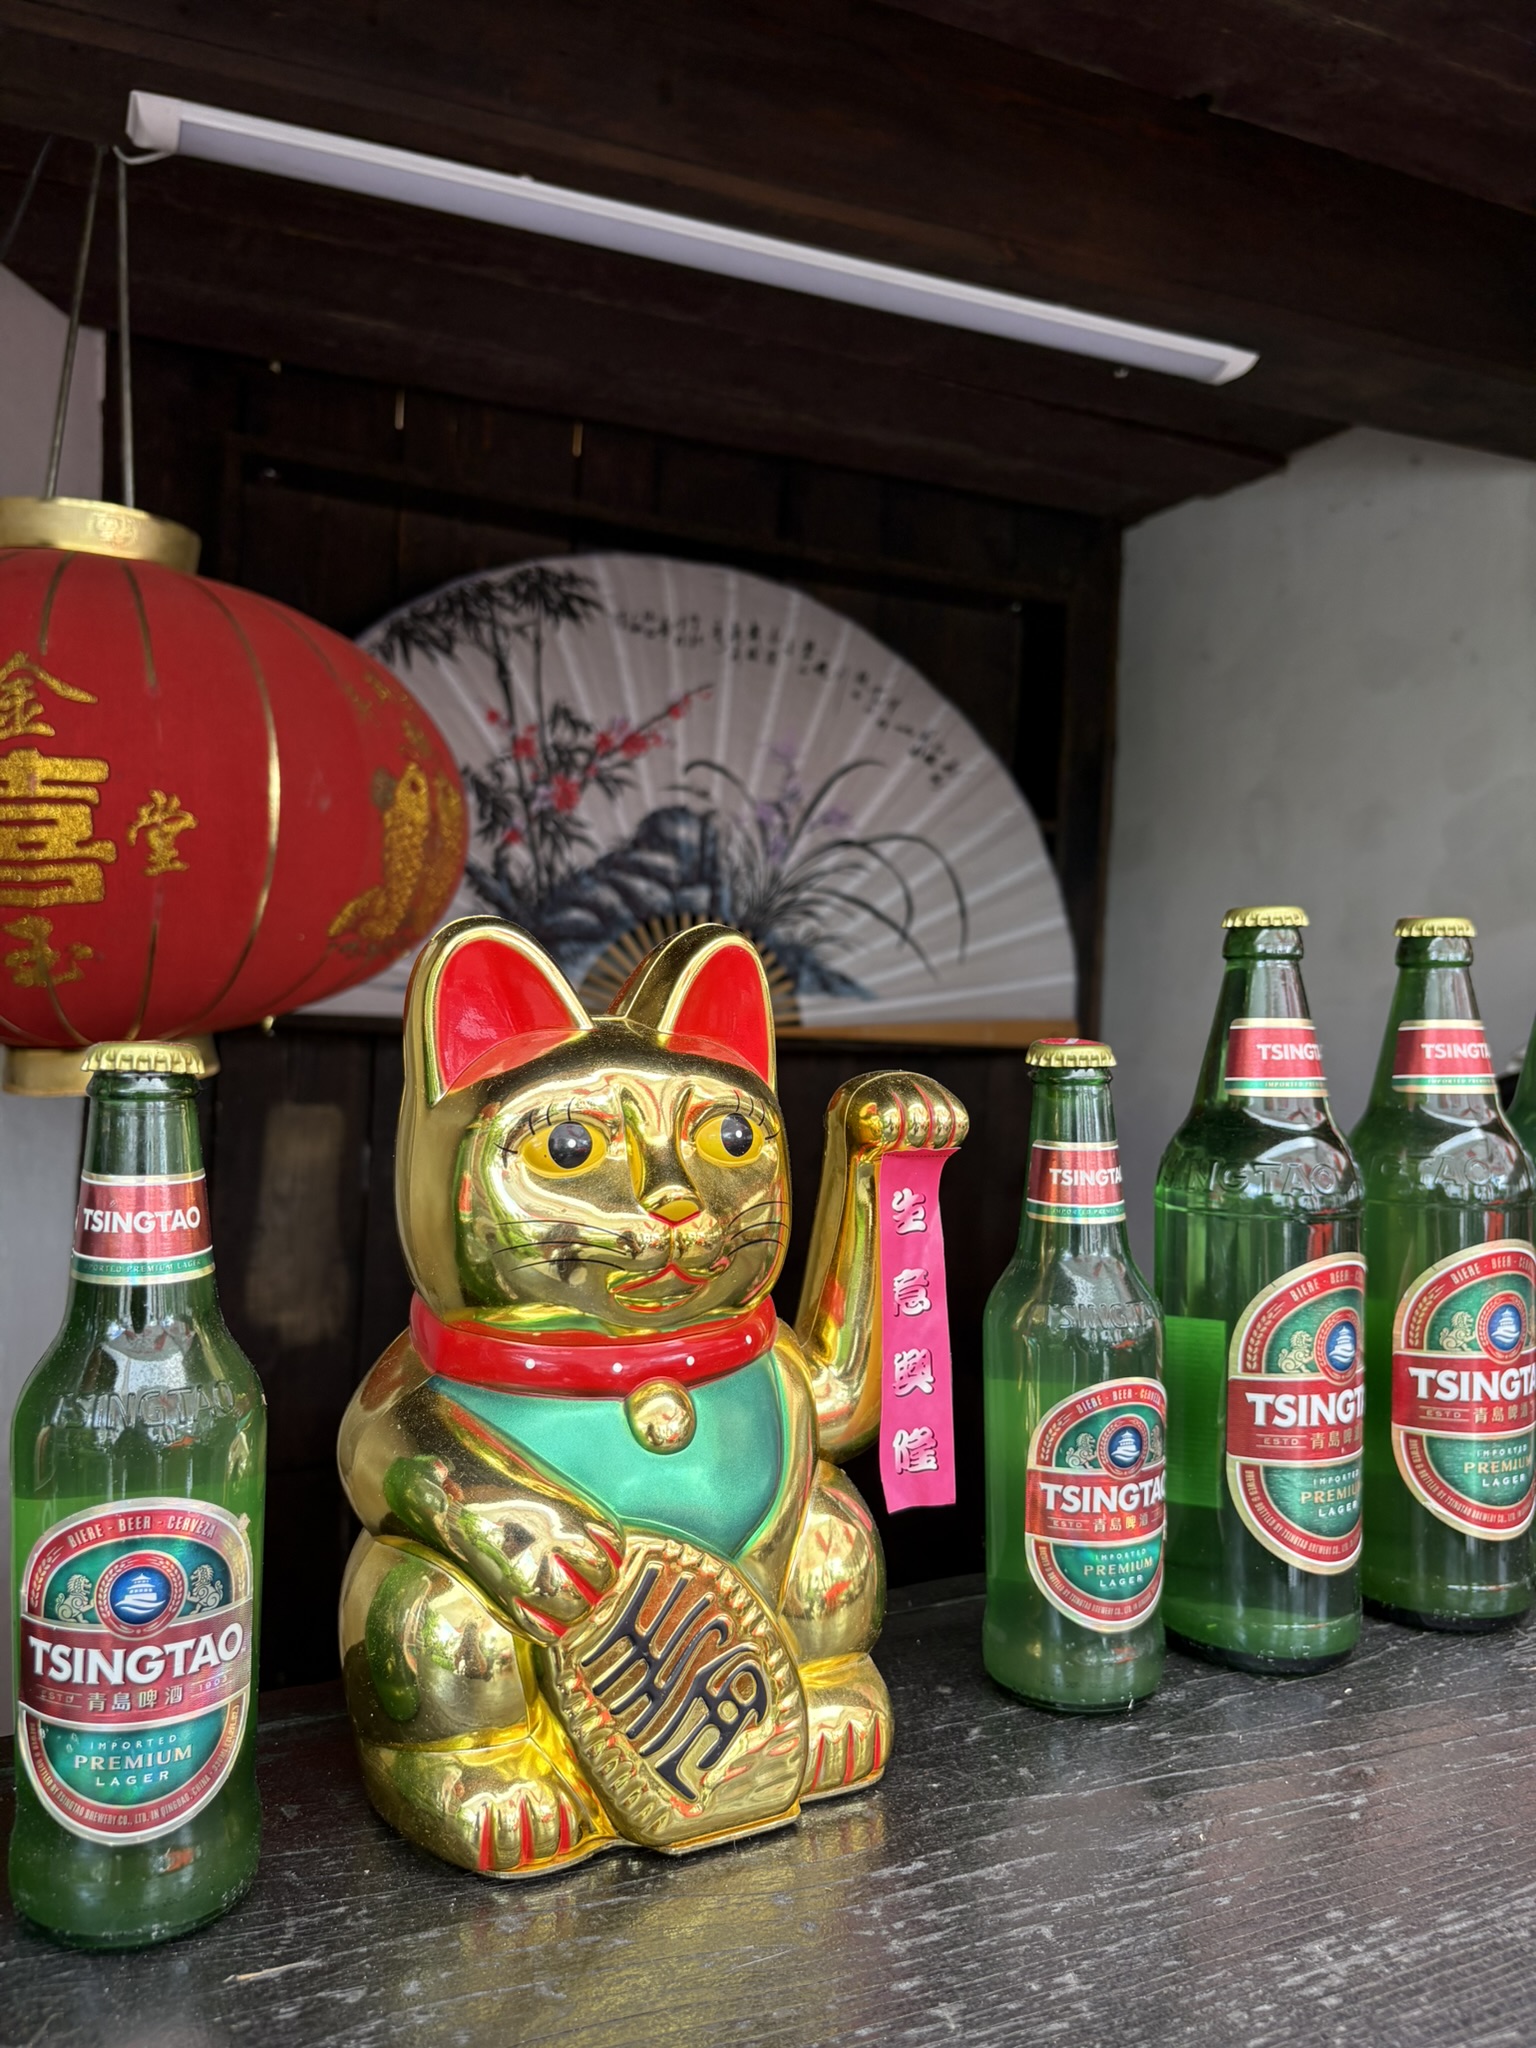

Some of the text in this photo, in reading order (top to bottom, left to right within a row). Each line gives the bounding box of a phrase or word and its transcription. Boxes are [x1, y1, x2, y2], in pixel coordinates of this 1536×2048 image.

[83, 1205, 201, 1234] TSINGTAO
[1450, 1262, 1481, 1285] BIERE
[1491, 1255, 1511, 1270] BEER
[1289, 1278, 1320, 1302] BIERE
[1329, 1269, 1349, 1284] BEER
[1075, 1395, 1103, 1414] BIERE
[1112, 1388, 1132, 1401] BEER
[1482, 1473, 1525, 1487] LAGER
[1318, 1500, 1358, 1517] LAGER
[67, 1515, 218, 1549] BIERE BEER CERVEZA
[1083, 1556, 1153, 1576] PREMIUM
[1095, 1548, 1147, 1561] IMPORTED
[1100, 1574, 1143, 1588] LAGER
[28, 1622, 244, 1685] TSINGTAO
[199, 1674, 228, 1691] 1903
[87, 1685, 183, 1713] 青島啤酒
[90, 1734, 177, 1751] IMPORTED
[74, 1744, 193, 1771] PREMIUM
[95, 1770, 169, 1787] LAGER
[50, 1783, 60, 1795] BY
[57, 1790, 85, 1816] TSINGTAO
[84, 1808, 116, 1825] BREWERY
[191, 1774, 211, 1796] CHINA
